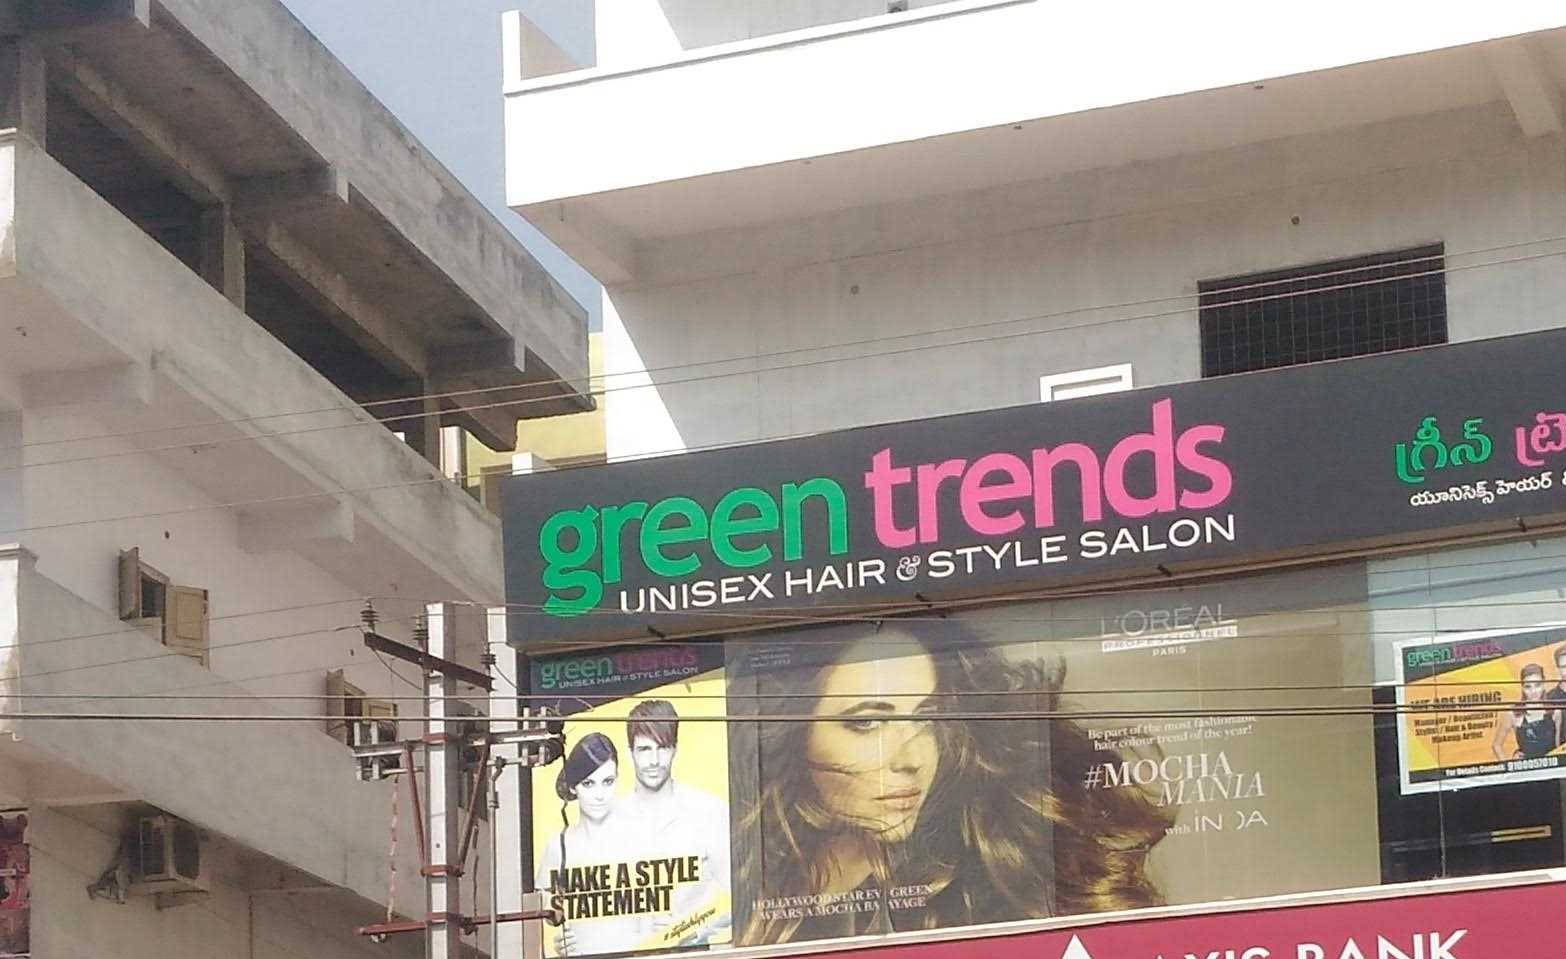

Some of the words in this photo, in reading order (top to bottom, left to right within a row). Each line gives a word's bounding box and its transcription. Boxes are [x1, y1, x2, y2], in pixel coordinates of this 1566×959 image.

[1394, 415, 1493, 483] గ్రీన్
[539, 477, 848, 617] green
[864, 398, 1233, 549] trends
[619, 576, 775, 614] UNISEX
[784, 558, 886, 595] HAIR
[896, 553, 922, 582] &
[927, 535, 1068, 578] STYLE
[1080, 514, 1236, 556] SALON
[1152, 646, 1187, 657] PARIS
[1406, 645, 1452, 667] green
[540, 656, 614, 690] green
[629, 670, 660, 681] STYLE
[662, 666, 699, 678] SALON
[1094, 739, 1117, 751] hair
[1084, 751, 1233, 790] #MOCHA
[1157, 771, 1266, 808] MANIA
[549, 863, 611, 895] MAKE
[615, 861, 632, 889] A
[635, 855, 700, 886] STYLE
[550, 885, 674, 922] STATEMENT
